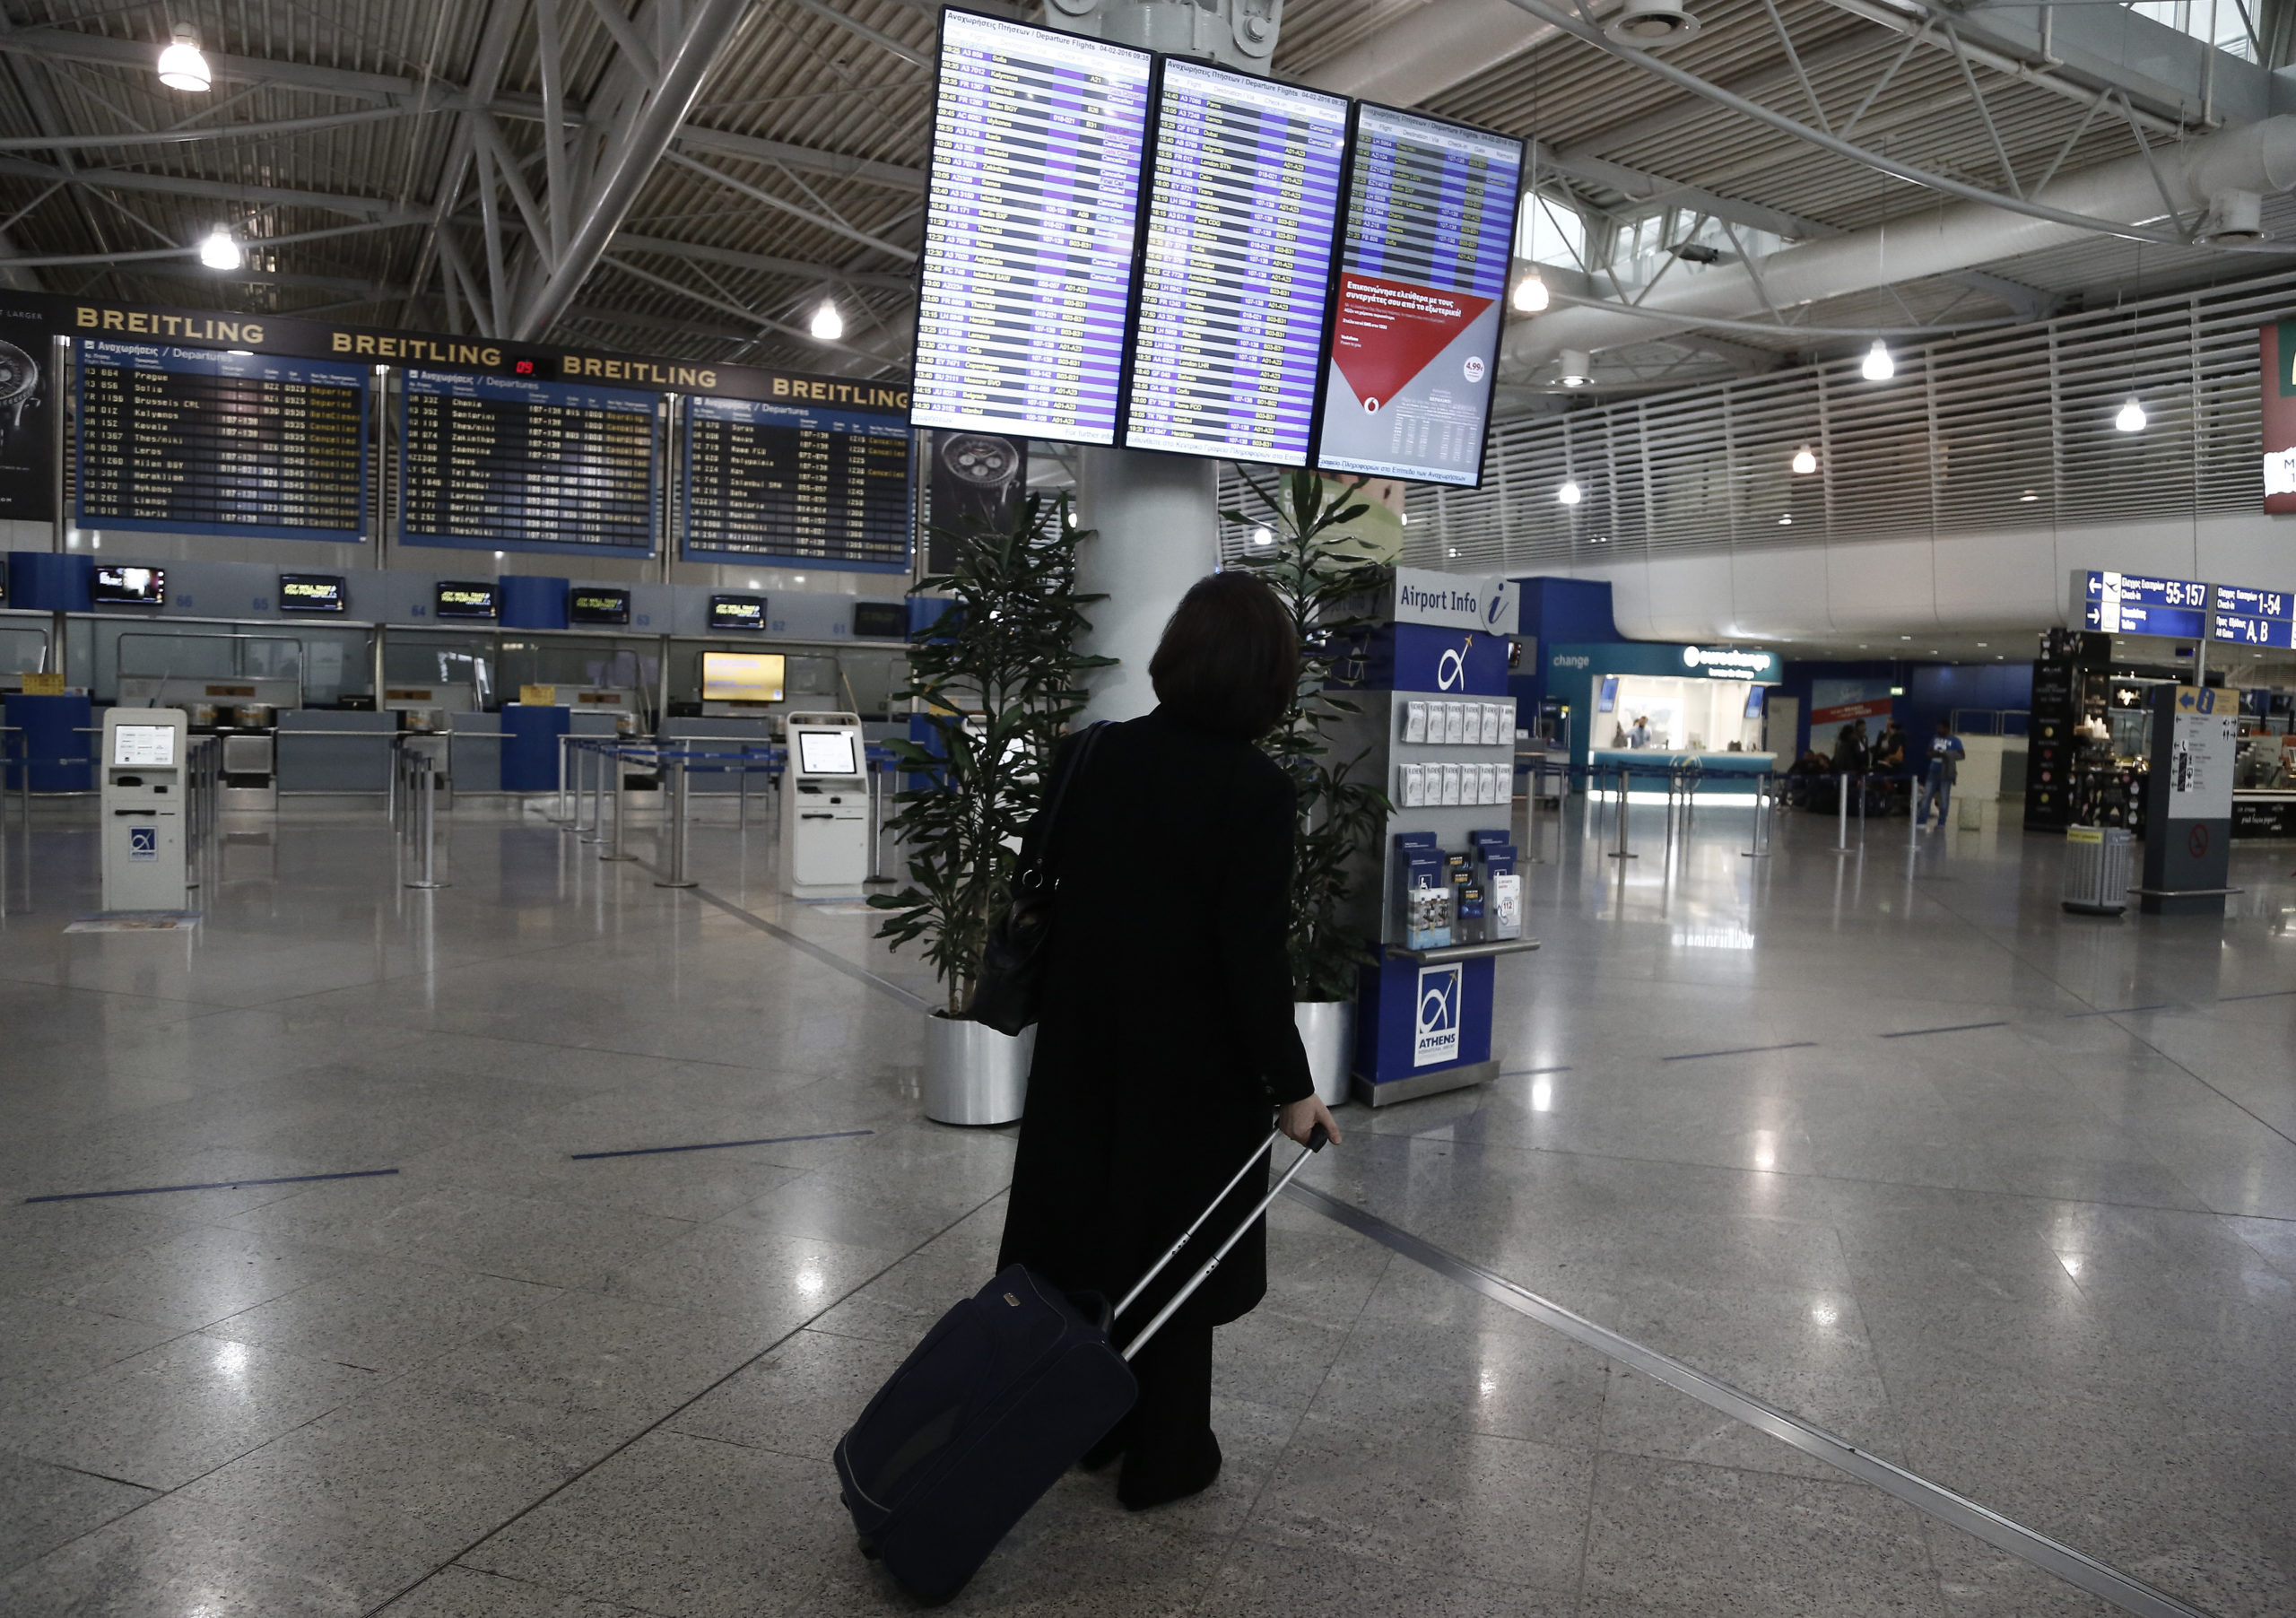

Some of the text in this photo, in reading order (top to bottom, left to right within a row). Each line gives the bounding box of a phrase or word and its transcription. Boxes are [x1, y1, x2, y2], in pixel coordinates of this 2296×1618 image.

[947, 12, 1149, 62] Αναχωρήσεις Πτήσεων Departure Flights 04-02-2016 09:35
[1167, 61, 1210, 77] Αναχωρήσεις
[1212, 72, 1239, 83] Πτήσεων
[1245, 79, 1274, 91] Departure
[1276, 86, 1298, 97] Flights
[1301, 91, 1331, 104] 04-02-2016
[1107, 94, 1134, 106] Cancelled
[1309, 123, 1333, 134] Cancelled
[1103, 139, 1129, 151] Cancelled
[1101, 154, 1127, 165] Cancelled
[1100, 169, 1126, 180] Cancelled
[1099, 184, 1125, 195] Cancelled
[1097, 199, 1123, 210] Cancelled
[1346, 280, 1396, 297] Επικοινώνησε
[1396, 289, 1428, 302] ελεύθερα
[1438, 299, 1453, 307] τους
[1345, 290, 1387, 305] συνεργάτες
[1387, 299, 1400, 307] σου
[1401, 300, 1415, 309] από
[1424, 304, 1461, 318] εξωτερικό!
[6, 310, 43, 320] LARGER
[76, 307, 264, 344] BREITLING
[99, 341, 159, 357] Αναχωρήσεις
[332, 333, 501, 366] BREITLING
[516, 361, 534, 374] 09
[563, 355, 717, 388] BREITLING
[135, 372, 169, 382] Prague
[487, 377, 539, 390] Departures
[772, 378, 909, 409] BREITLING
[762, 404, 809, 416] Departures
[1401, 585, 1476, 613] Airport Info
[2121, 589, 2142, 600] Check-in
[2166, 581, 2205, 606] 55-157
[2217, 599, 2235, 610] Check-in
[2258, 592, 2281, 616] 1-54
[2260, 621, 2269, 643] B
[1553, 655, 1589, 668] change
[1419, 1033, 1456, 1048] ATHENS
